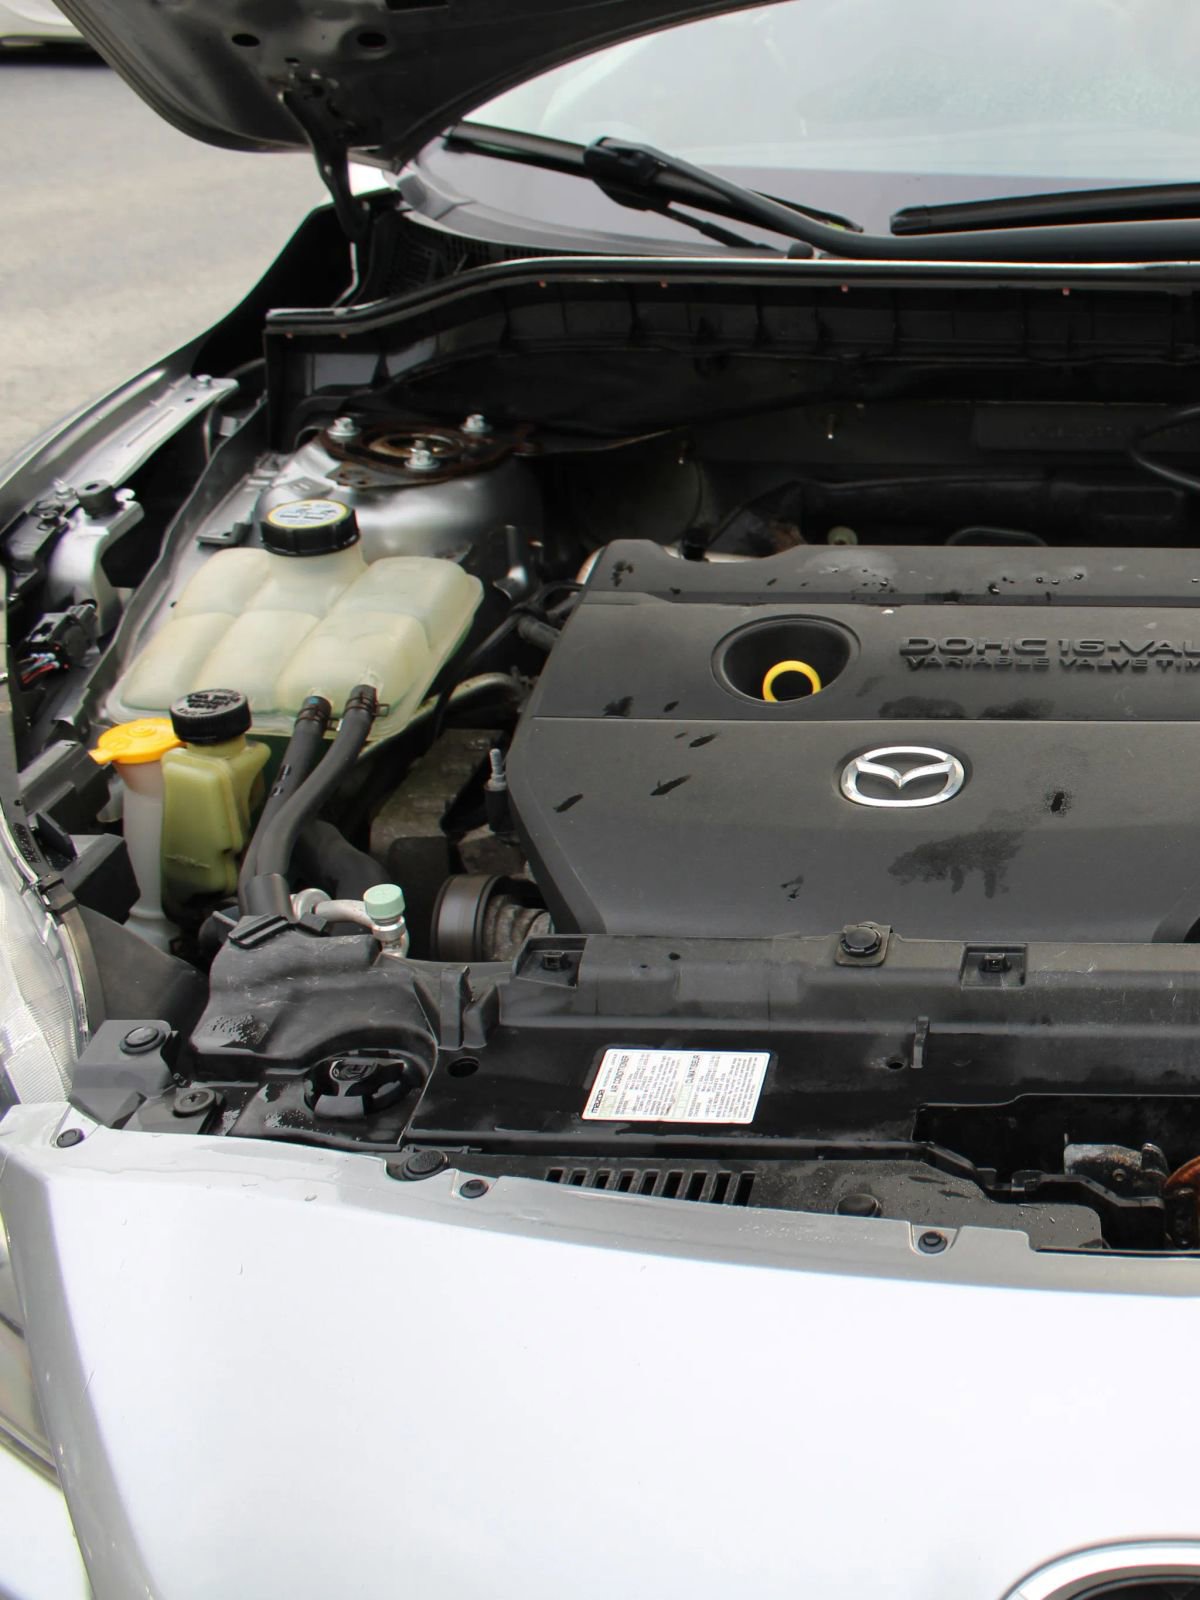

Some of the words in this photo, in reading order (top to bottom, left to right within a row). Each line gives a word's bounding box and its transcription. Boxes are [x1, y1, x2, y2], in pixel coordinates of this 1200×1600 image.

[899, 636, 1047, 656] DOHC
[905, 655, 1050, 672] VARIABLE
[1059, 656, 1148, 673] VALVE
